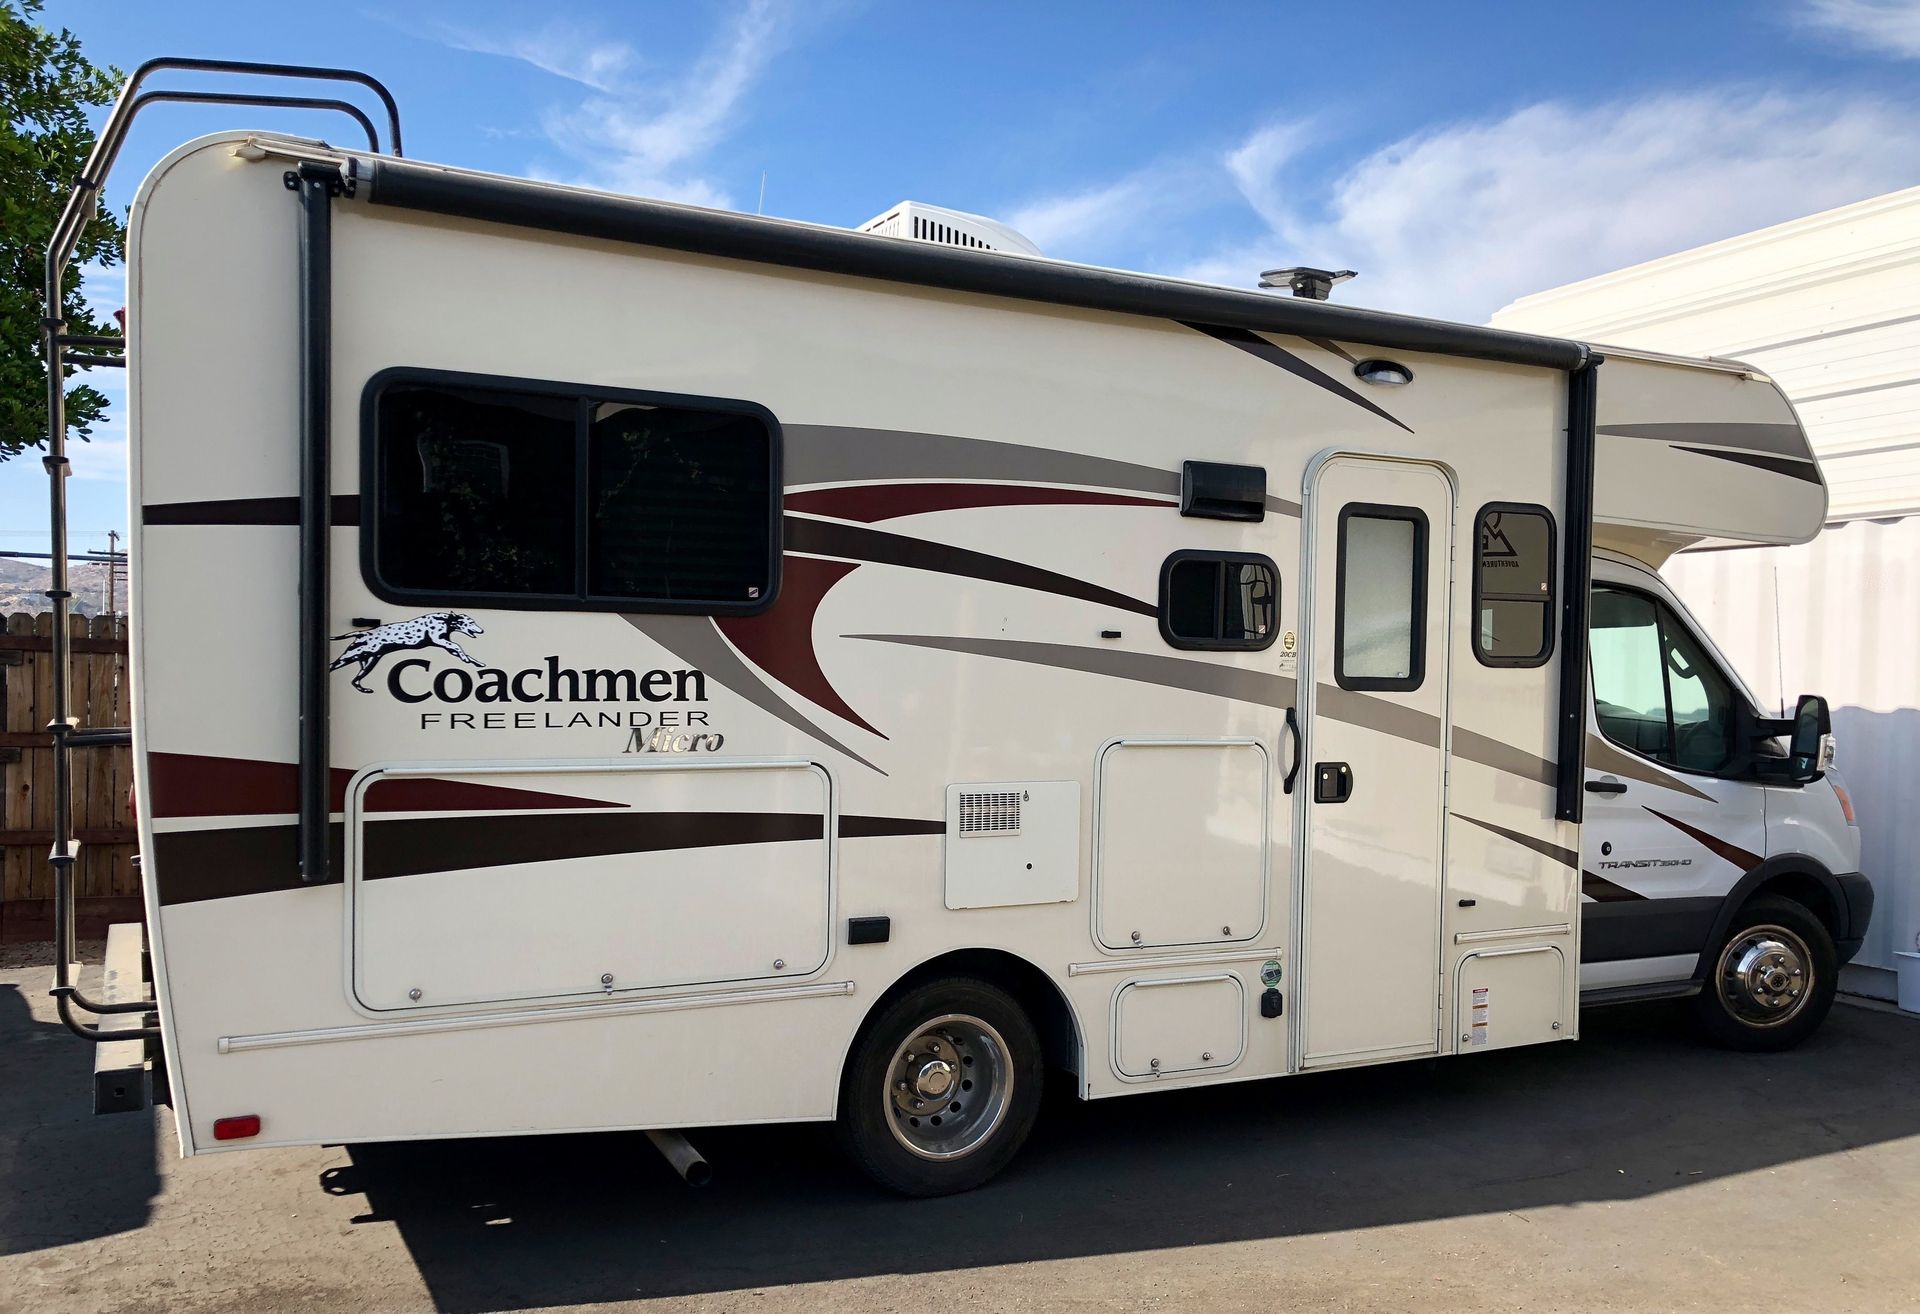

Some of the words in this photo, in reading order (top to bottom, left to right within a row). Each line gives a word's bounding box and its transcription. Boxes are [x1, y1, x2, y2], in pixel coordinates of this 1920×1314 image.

[387, 656, 708, 703] Coachmen
[421, 711, 709, 729] FREELANDER
[622, 727, 724, 753] Micro
